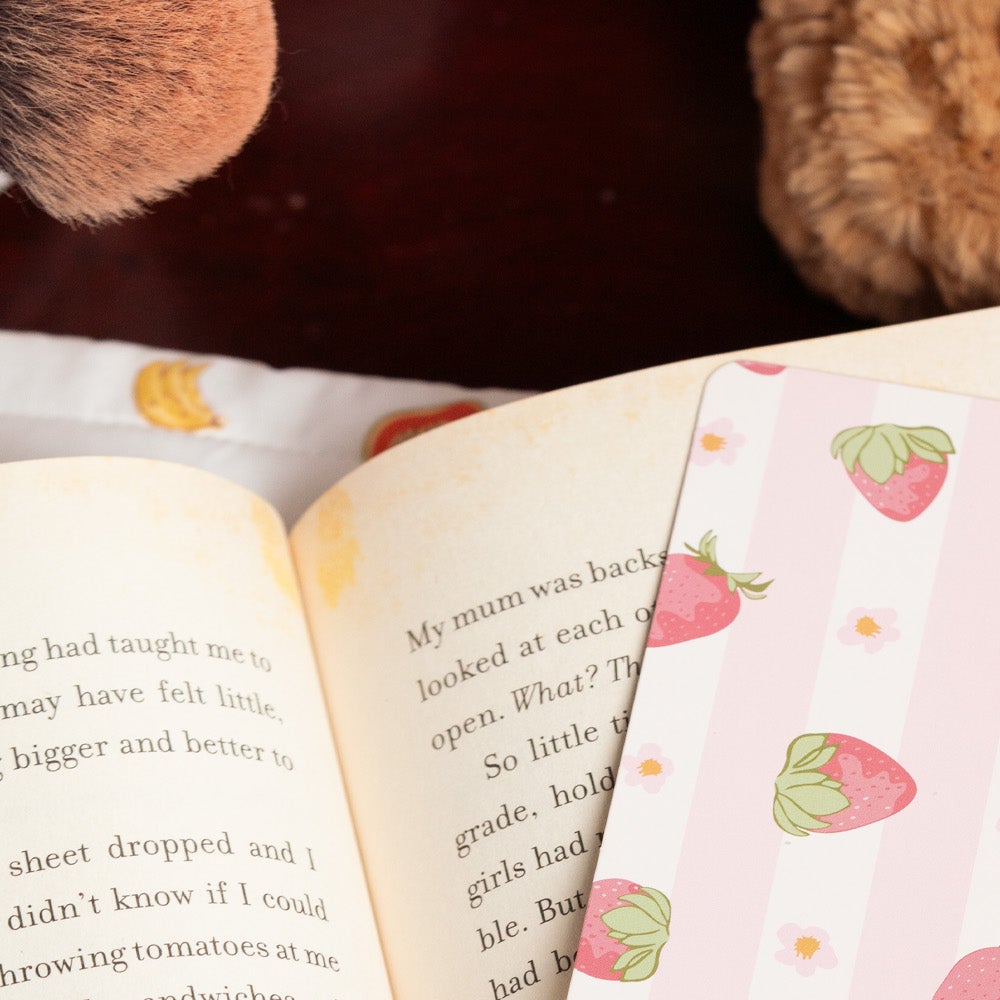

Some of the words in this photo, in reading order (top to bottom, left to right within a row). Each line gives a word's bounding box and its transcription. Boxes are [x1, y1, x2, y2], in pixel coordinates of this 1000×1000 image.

[407, 621, 443, 652] My
[452, 592, 525, 630] mum
[530, 574, 582, 598] was
[42, 633, 100, 660] had
[107, 632, 199, 661] taught
[206, 643, 244, 663] me
[250, 651, 271, 672] to
[416, 642, 510, 703] looked
[520, 635, 545, 657] at
[557, 609, 624, 644] each
[0, 696, 61, 720] may
[74, 685, 144, 707] have
[158, 680, 206, 704] felt
[432, 710, 504, 751] open.
[511, 664, 598, 712] What?
[11, 741, 108, 772] bigger
[120, 730, 174, 754] and
[182, 730, 264, 761] better
[272, 749, 293, 771] to
[484, 753, 517, 779] So
[527, 724, 598, 761] little
[455, 803, 538, 860] grade,
[549, 767, 615, 808] hold
[9, 844, 90, 876] sheet
[108, 832, 234, 862] dropped
[250, 841, 296, 864] and
[306, 848, 315, 871] I
[468, 860, 526, 909] girls
[531, 830, 588, 872] had
[8, 893, 101, 930] didn't
[111, 888, 193, 911] know
[207, 881, 227, 904] if
[239, 883, 251, 905] I
[263, 893, 328, 921] could
[476, 920, 527, 952] ble.
[535, 888, 587, 925] But
[132, 937, 269, 961] tomatoes
[276, 943, 299, 961] at
[304, 949, 339, 972] me
